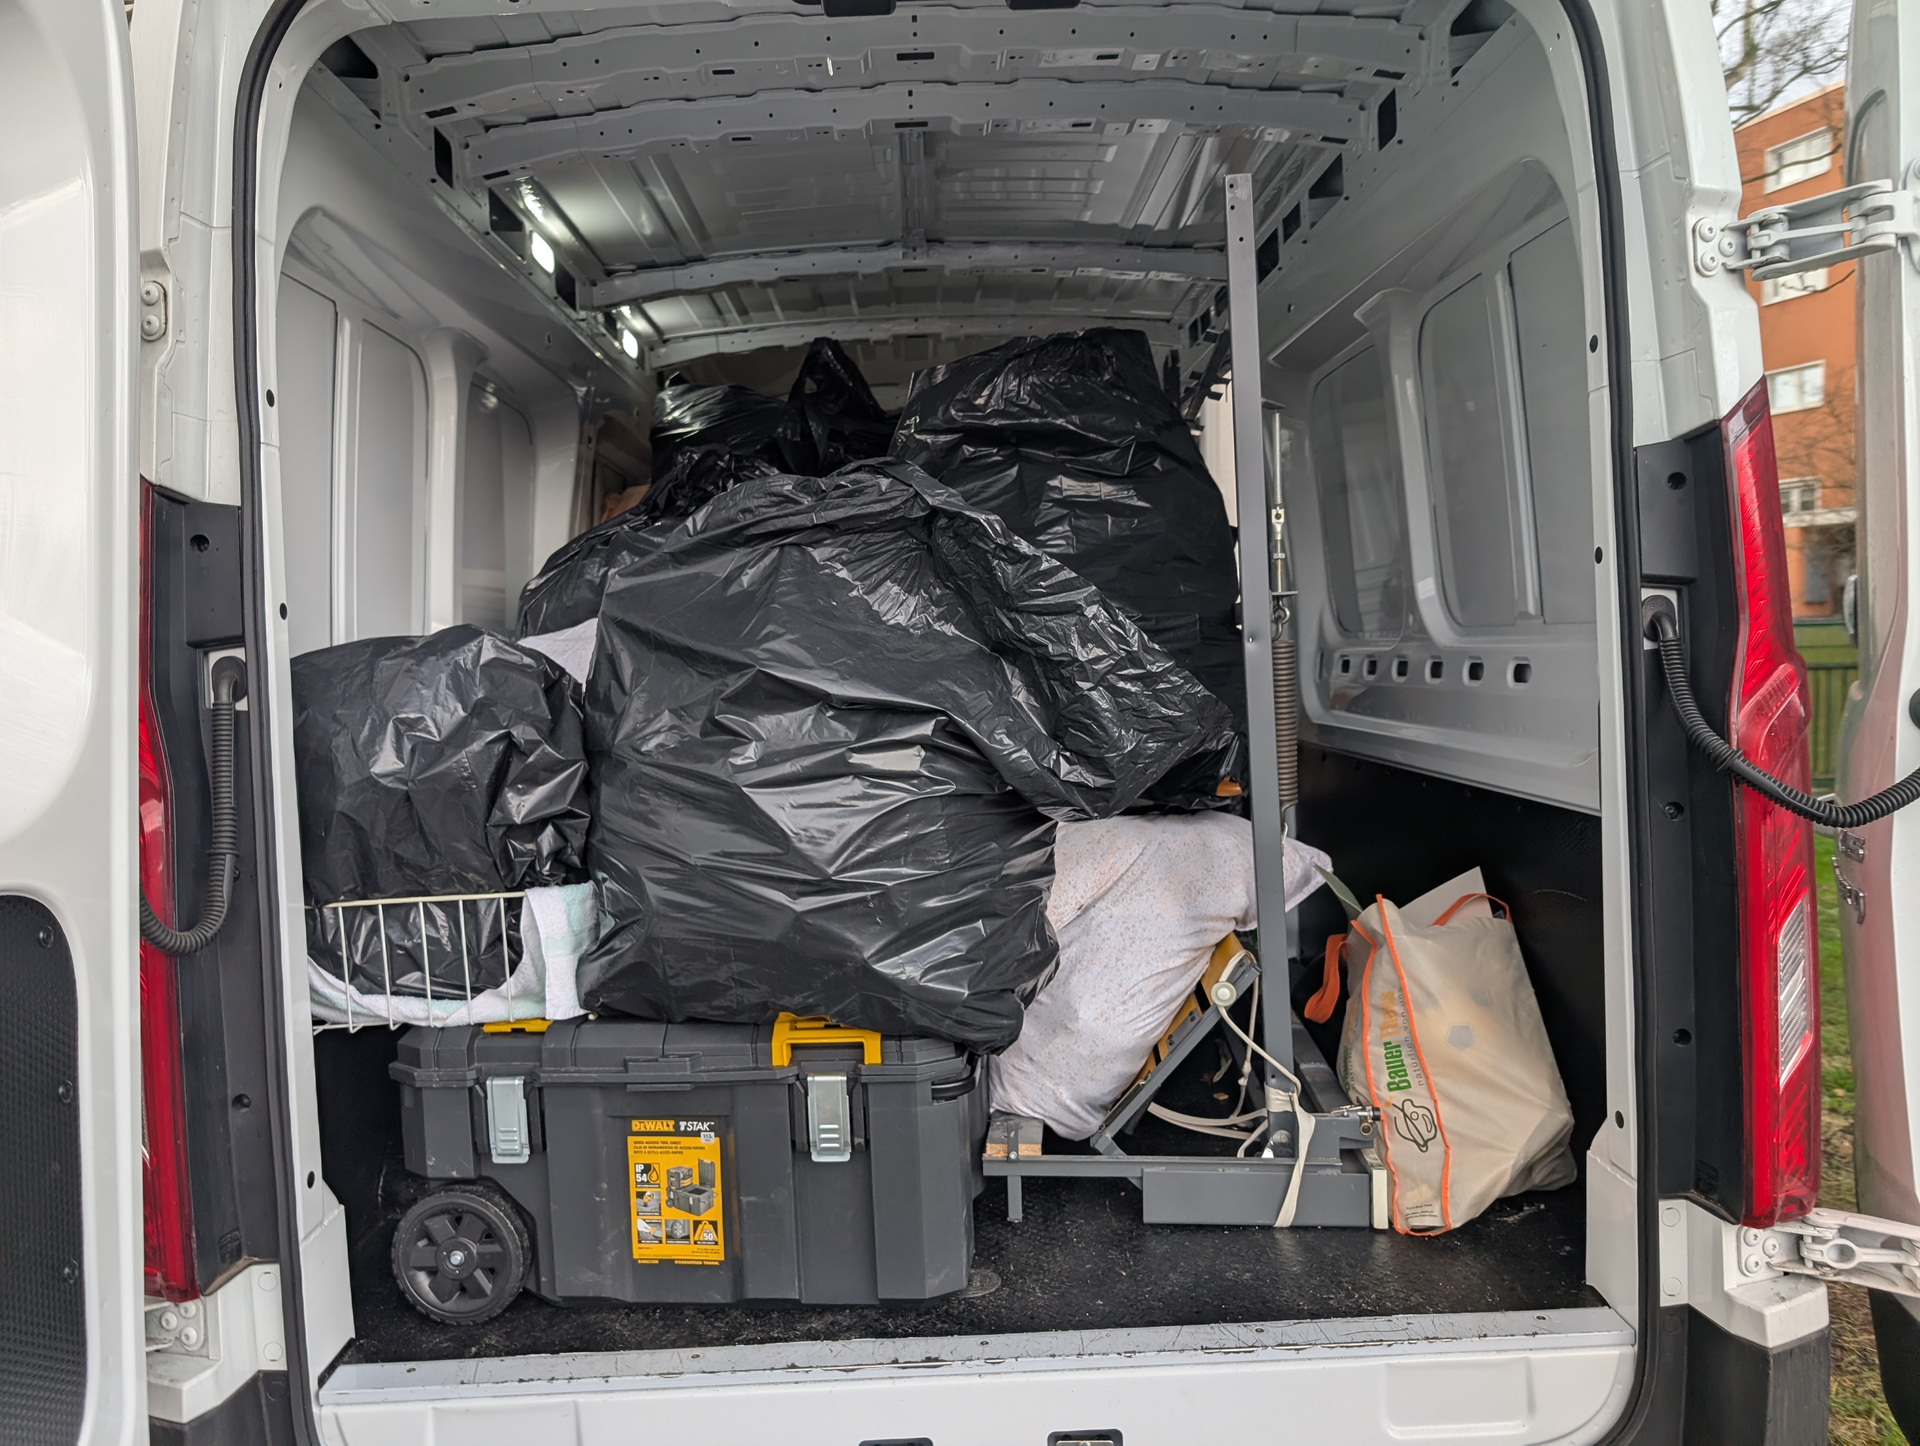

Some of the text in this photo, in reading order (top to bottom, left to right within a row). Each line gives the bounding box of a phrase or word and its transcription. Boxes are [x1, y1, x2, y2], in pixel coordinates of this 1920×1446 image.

[1403, 1036, 1425, 1086] natürlich
[1382, 1041, 1412, 1092] Bauer
[635, 1164, 644, 1172] IP
[636, 1173, 648, 1182] 54
[703, 1232, 714, 1241] 50
